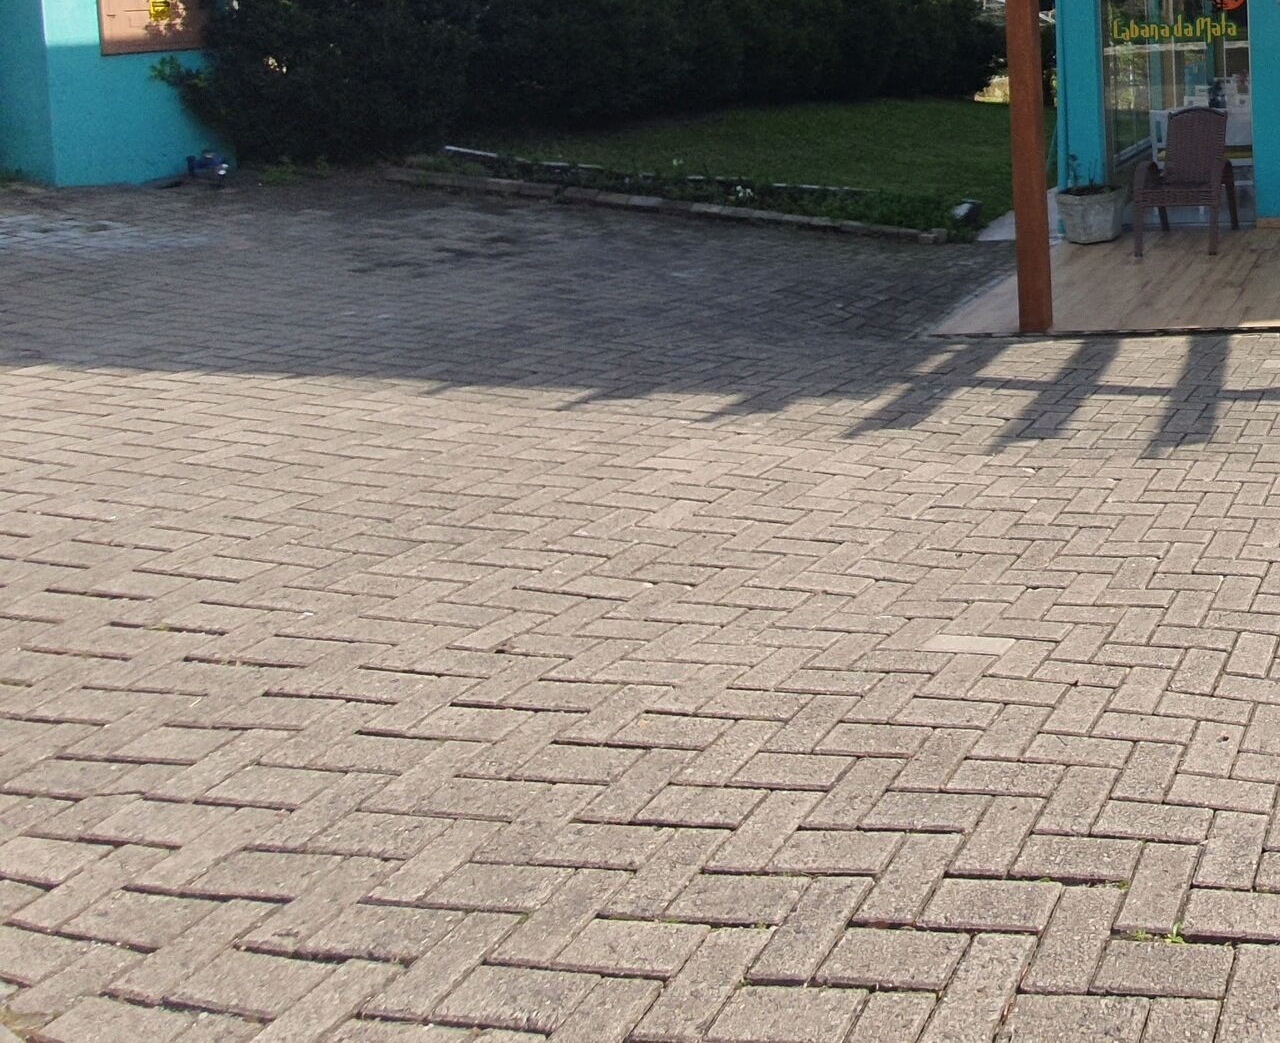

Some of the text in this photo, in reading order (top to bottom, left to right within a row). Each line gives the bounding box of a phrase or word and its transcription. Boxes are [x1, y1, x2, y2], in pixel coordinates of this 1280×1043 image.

[1113, 12, 1237, 44] Cabana da Mata
